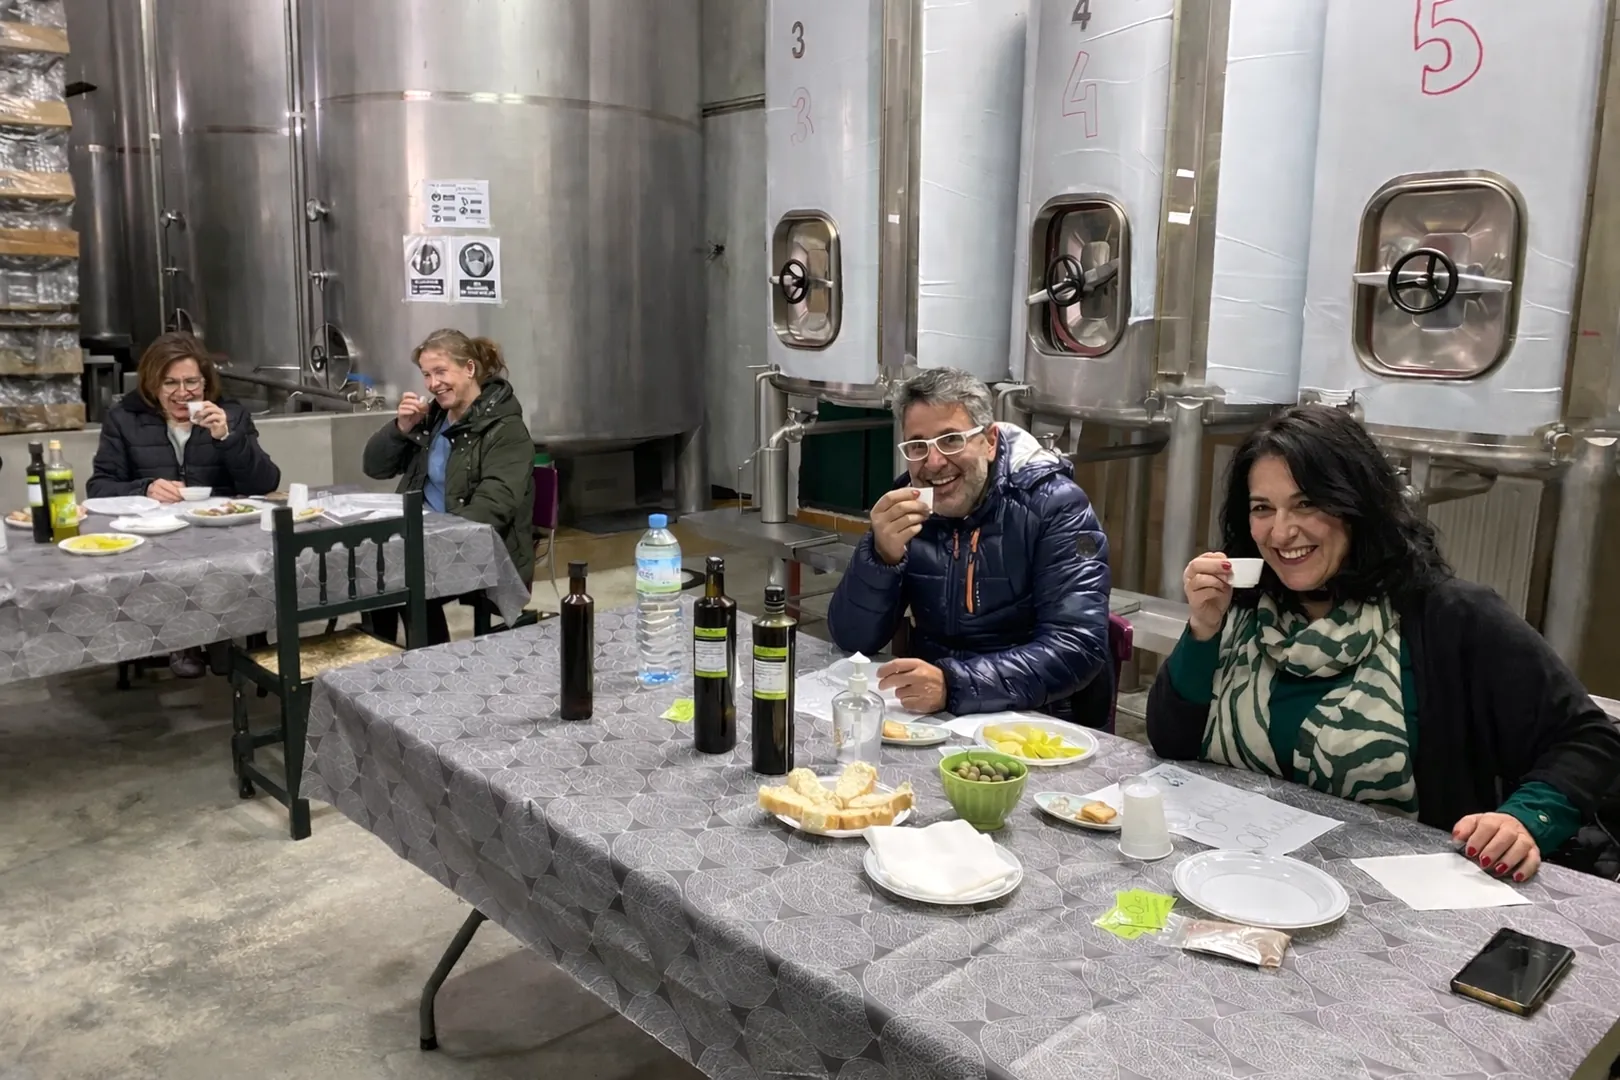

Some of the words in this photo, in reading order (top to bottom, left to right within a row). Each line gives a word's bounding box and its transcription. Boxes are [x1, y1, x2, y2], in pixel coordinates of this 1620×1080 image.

[792, 20, 806, 59] 3
[1071, 0, 1092, 31] 4
[1414, 0, 1484, 95] 5
[790, 86, 814, 146] 3
[1062, 50, 1098, 138] 4
